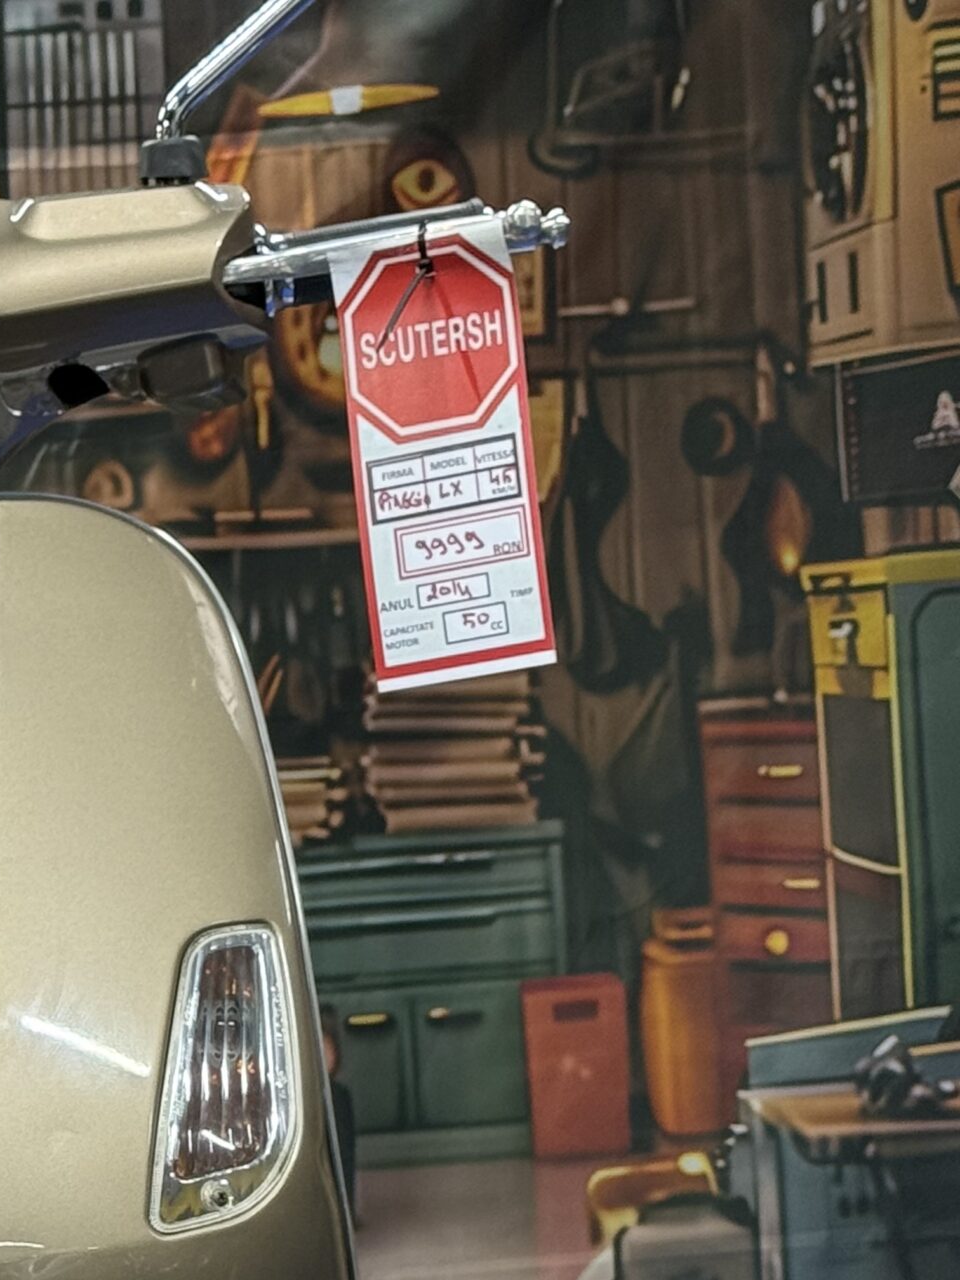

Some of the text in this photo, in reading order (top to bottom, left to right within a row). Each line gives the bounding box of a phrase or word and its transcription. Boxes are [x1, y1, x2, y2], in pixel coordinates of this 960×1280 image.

[359, 308, 503, 370] SCUTERSH
[381, 467, 415, 482] FIRMA
[430, 455, 468, 472] MODEL
[440, 480, 463, 498] LX
[414, 530, 485, 561] 9999
[492, 540, 525, 556] RON
[380, 598, 415, 614] ANUL
[461, 612, 490, 629] 50
[385, 637, 420, 651] MOTOR
